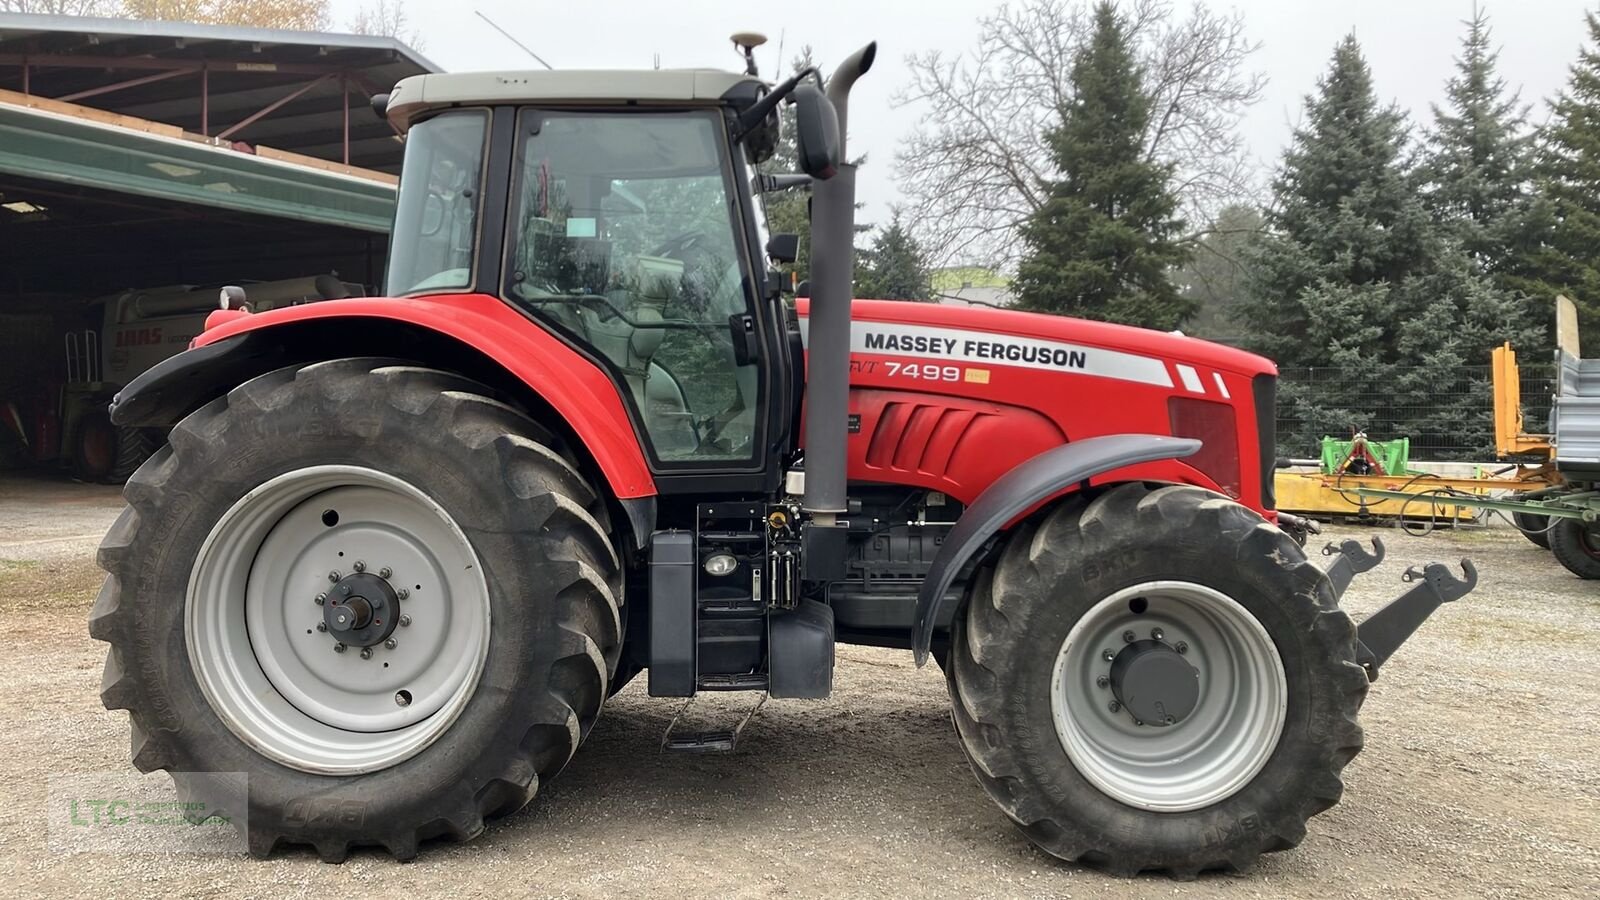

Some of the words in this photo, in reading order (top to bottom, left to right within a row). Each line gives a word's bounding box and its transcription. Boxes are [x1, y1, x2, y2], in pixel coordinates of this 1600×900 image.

[864, 333, 957, 354] MASSEY
[963, 340, 1086, 368] FERGUSON
[884, 361, 960, 381] 7499
